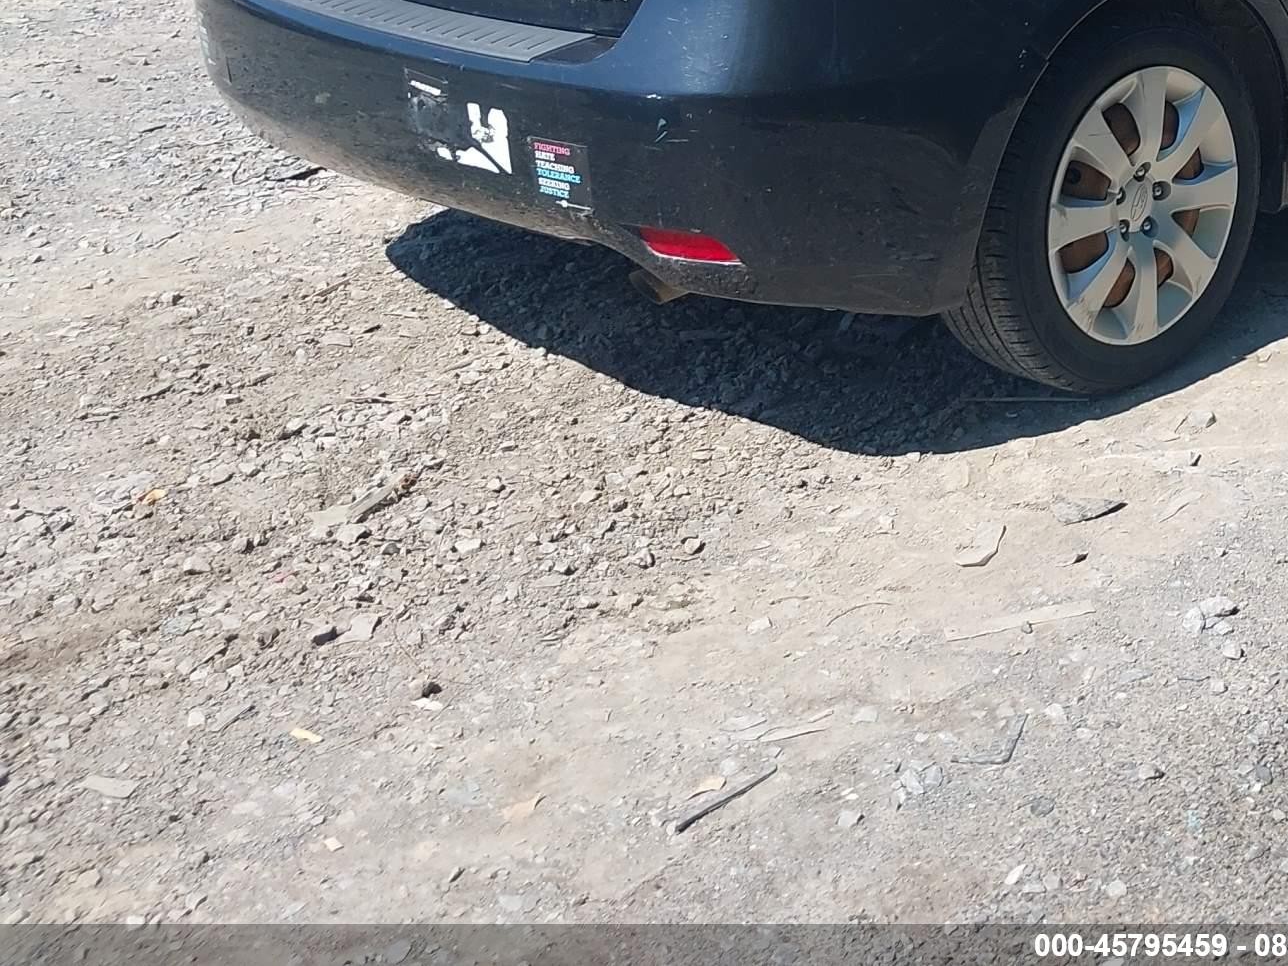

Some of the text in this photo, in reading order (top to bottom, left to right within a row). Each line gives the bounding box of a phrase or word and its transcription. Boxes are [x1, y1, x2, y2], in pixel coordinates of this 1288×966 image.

[533, 142, 571, 156] FIGHTING
[535, 159, 575, 175] TEACHING
[536, 167, 581, 184] TOLERANCE
